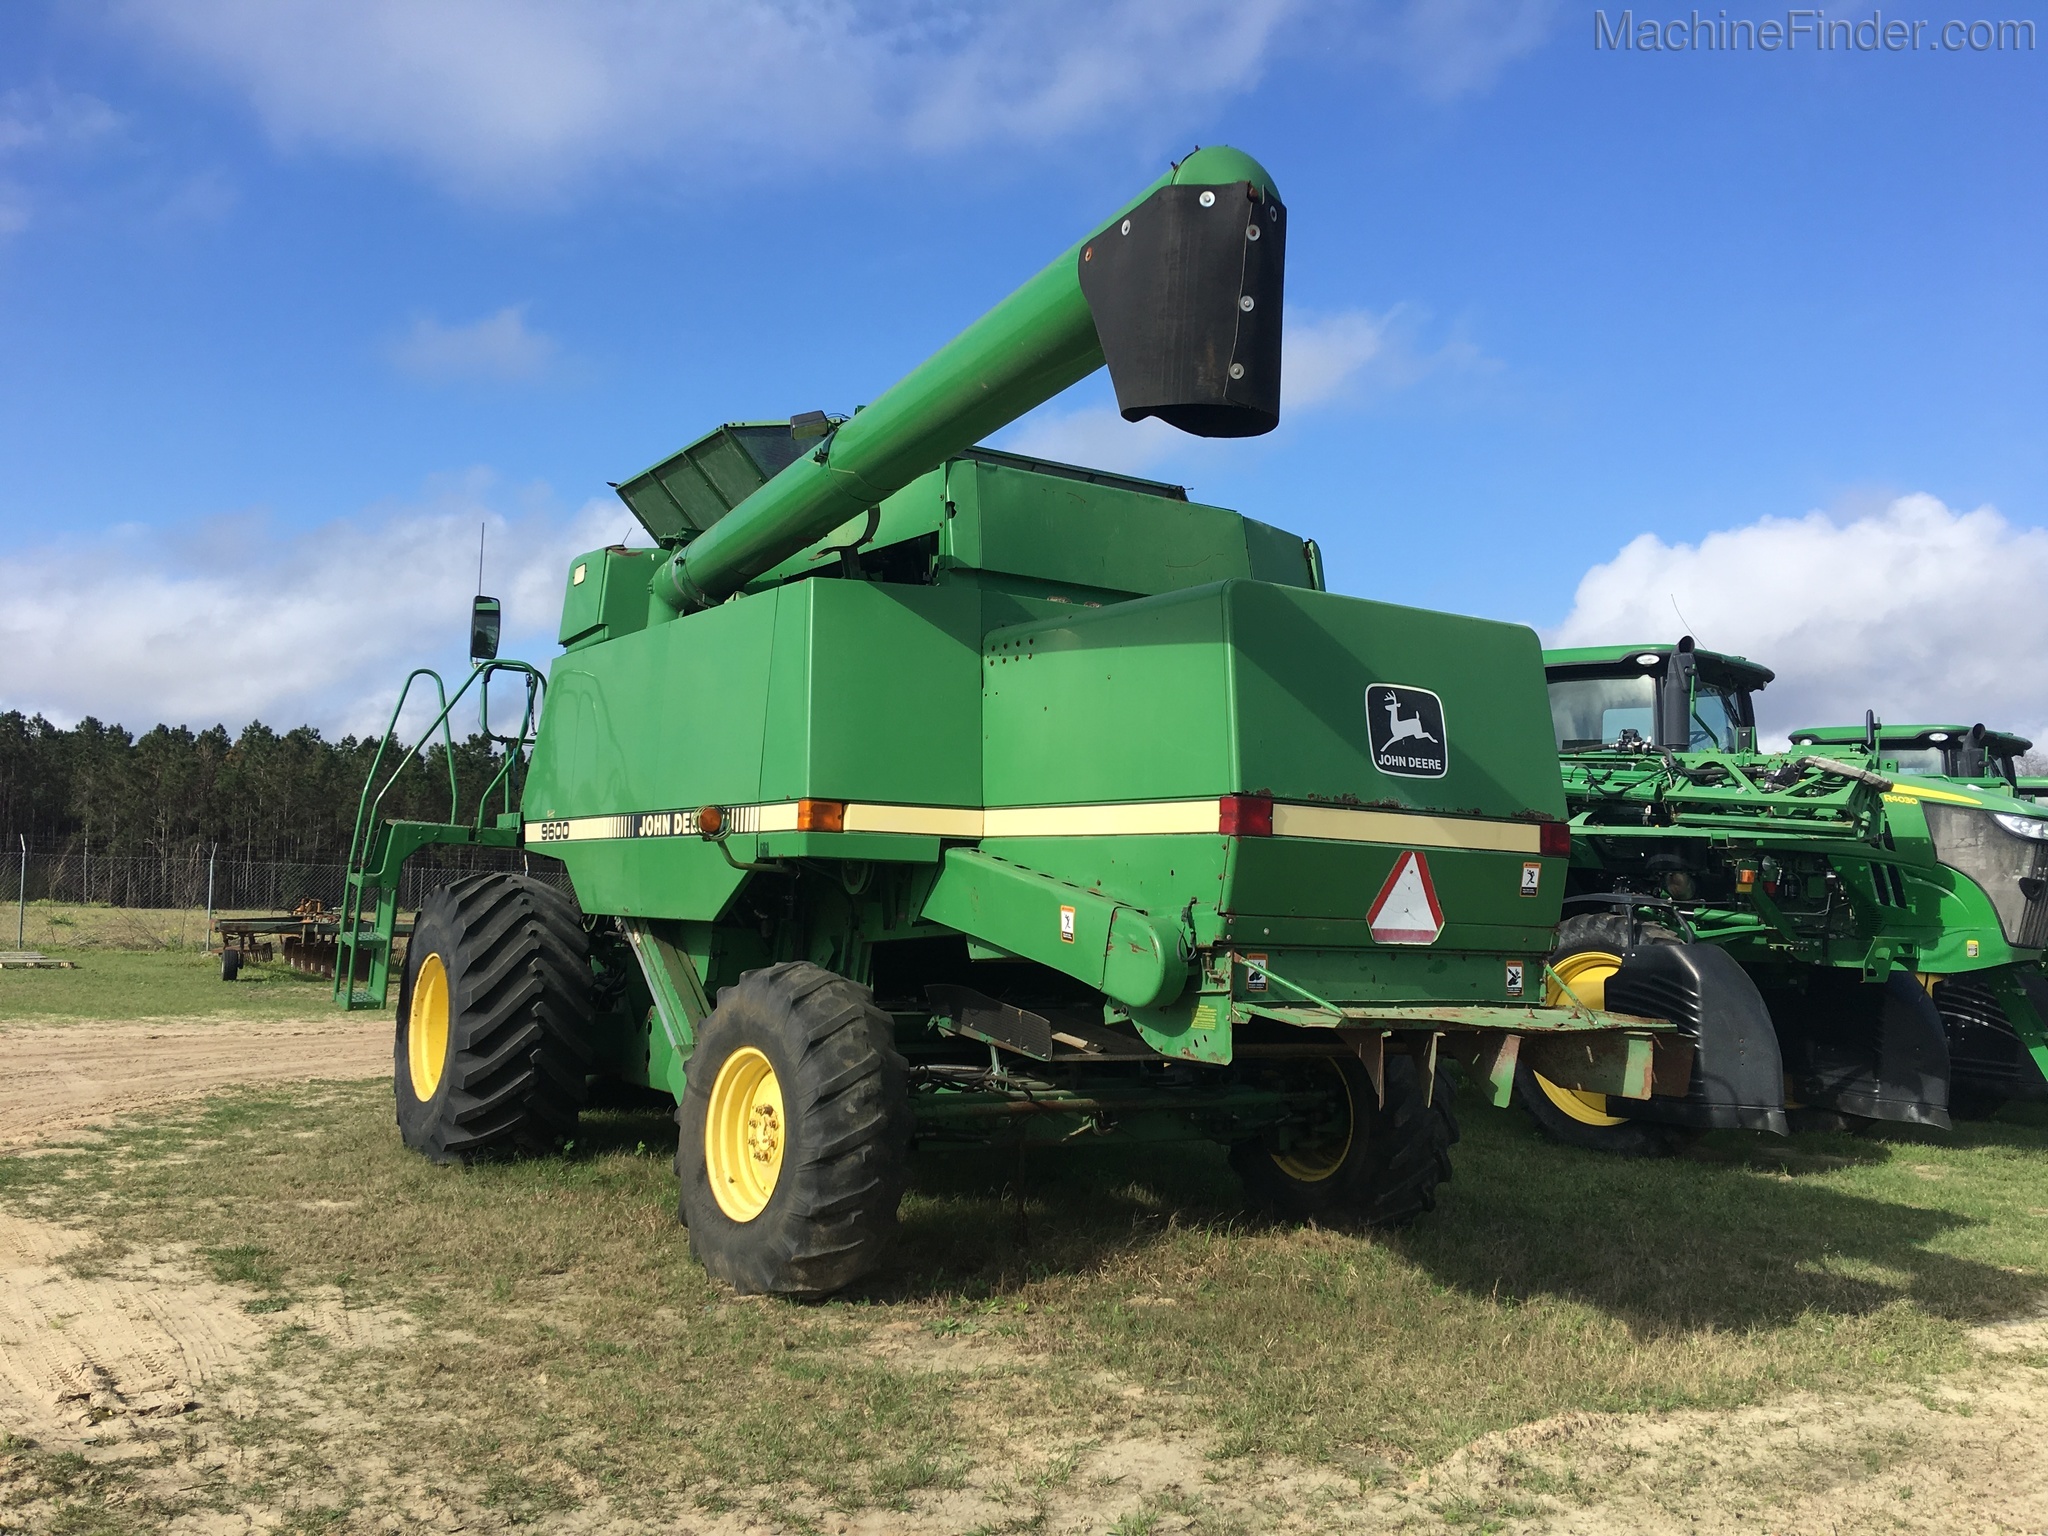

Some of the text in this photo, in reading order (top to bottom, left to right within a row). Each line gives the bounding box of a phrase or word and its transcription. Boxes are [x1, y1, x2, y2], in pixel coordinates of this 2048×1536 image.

[1379, 755, 1441, 770] JOHN DEERE
[1884, 795, 1917, 804] R4030
[541, 821, 570, 841] 9600
[638, 813, 671, 837] JOHN
